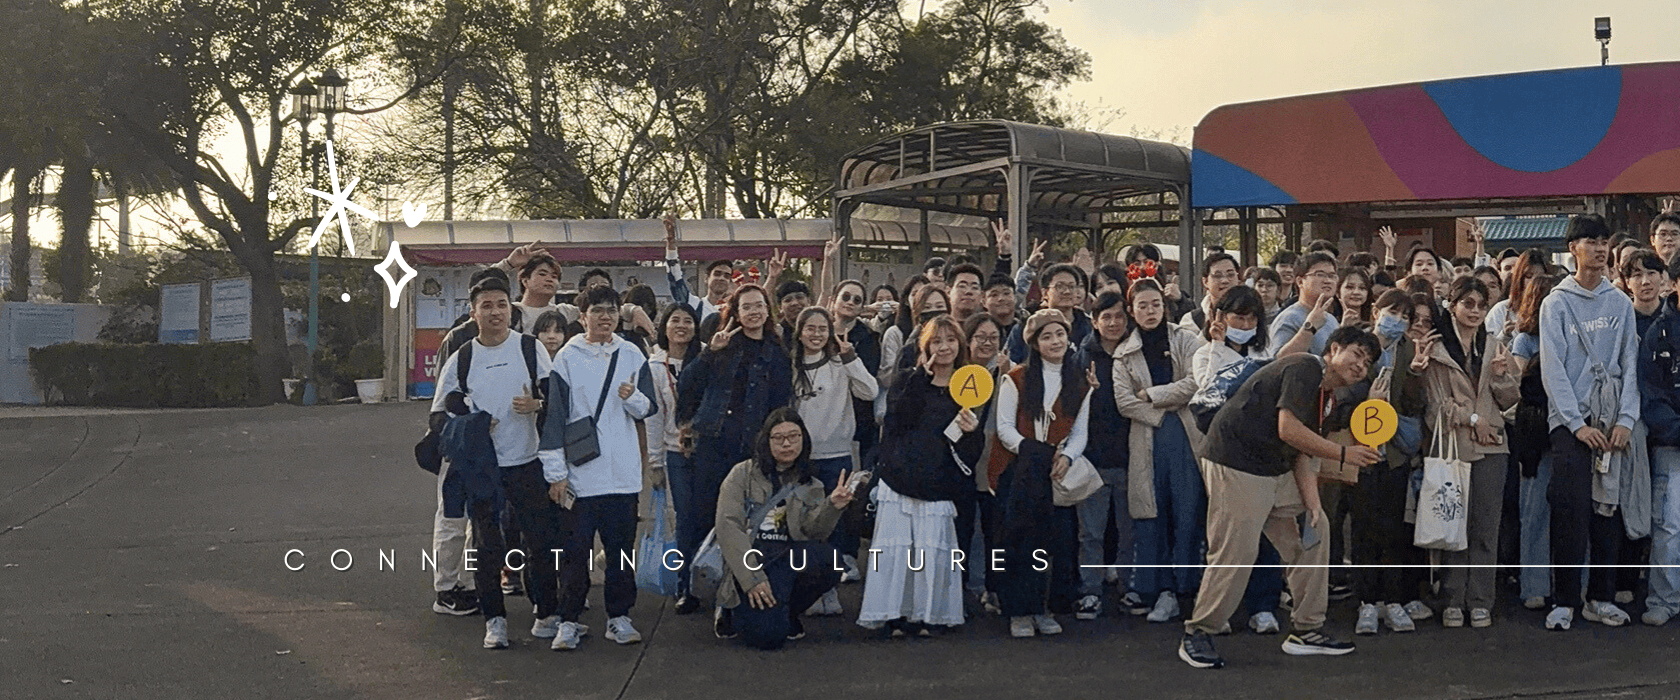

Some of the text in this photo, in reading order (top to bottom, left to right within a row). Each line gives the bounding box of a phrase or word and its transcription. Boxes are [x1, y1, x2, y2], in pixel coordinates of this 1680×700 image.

[1568, 316, 1610, 336] KWISS
[959, 373, 979, 399] A
[1364, 406, 1384, 436] B
